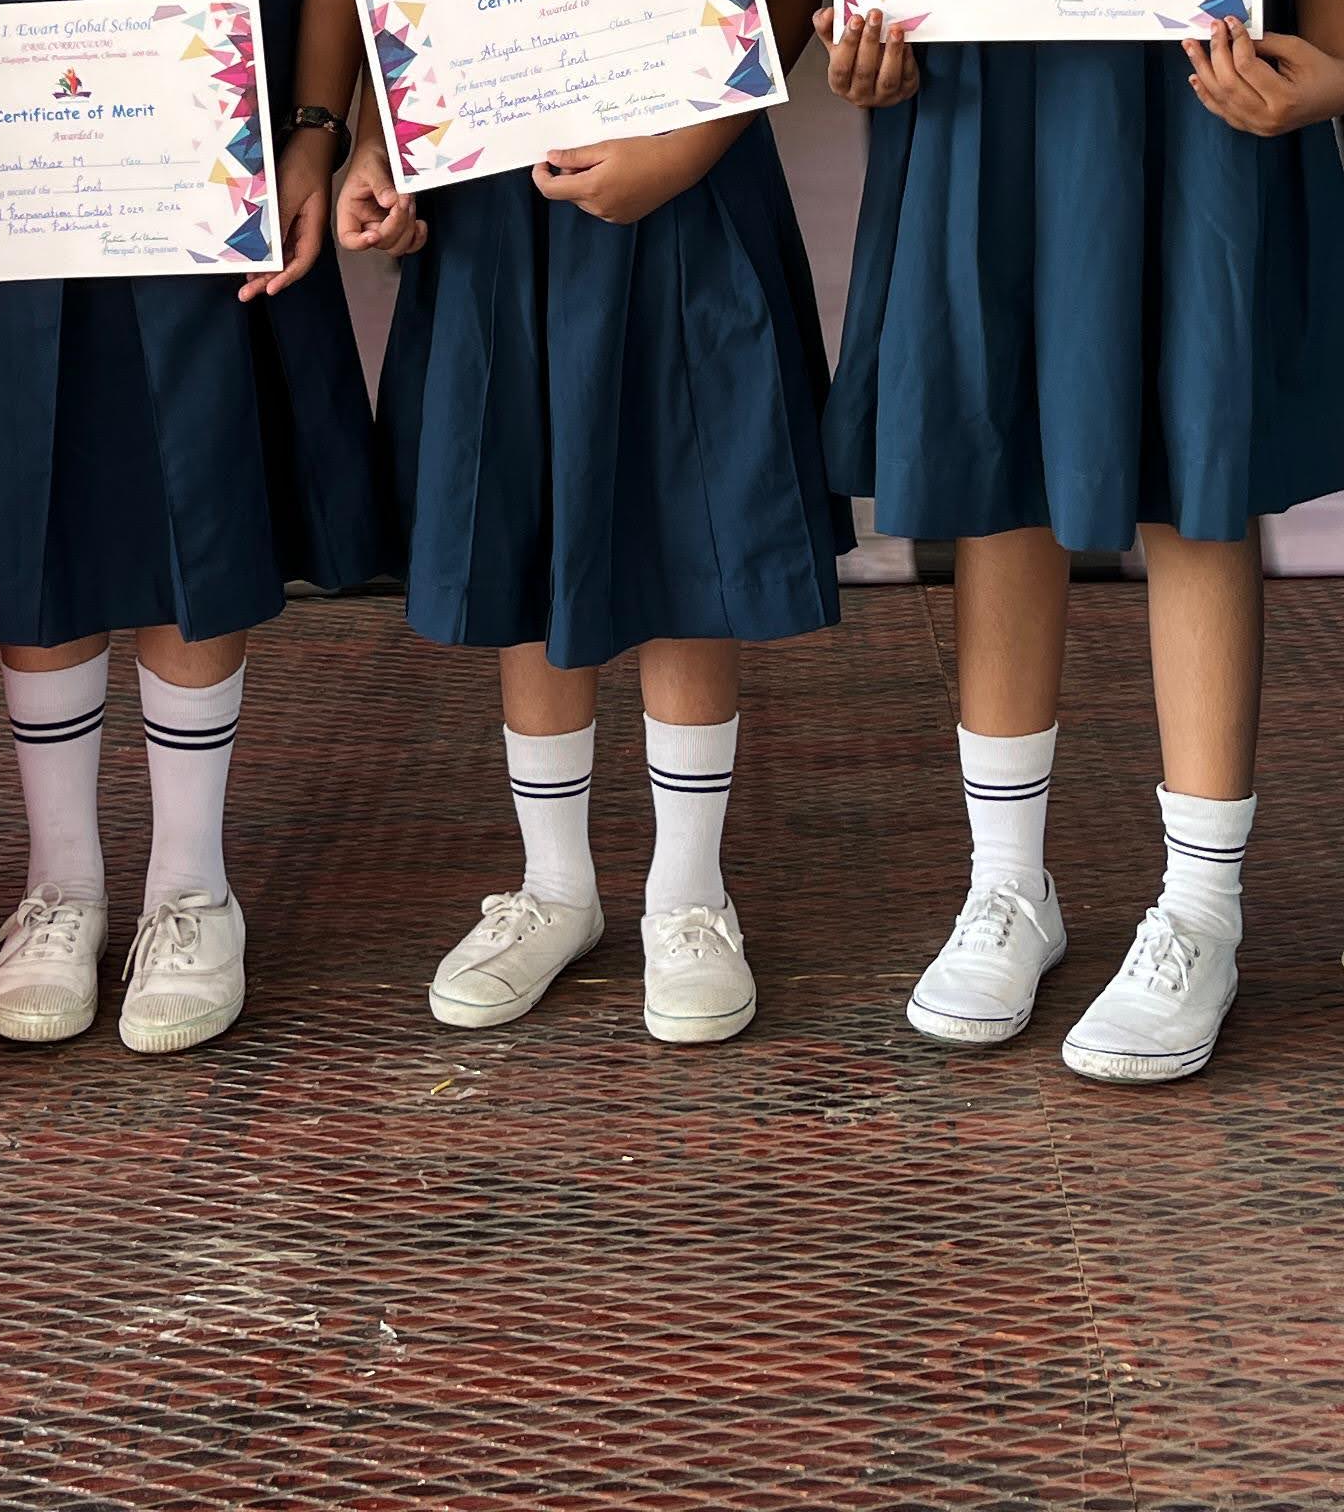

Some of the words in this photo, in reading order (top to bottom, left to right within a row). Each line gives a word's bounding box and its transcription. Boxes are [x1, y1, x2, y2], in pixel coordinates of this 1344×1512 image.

[536, 1, 577, 19] Awarded
[16, 23, 59, 37] Ewart
[64, 18, 106, 38] Global
[109, 15, 154, 33] School
[531, 29, 580, 51] Mariam
[496, 87, 557, 109] Preparation
[565, 75, 598, 93] Contest
[87, 105, 104, 119] of
[112, 103, 155, 119] Merit
[52, 130, 93, 143] Awarded
[72, 155, 86, 168] M
[7, 202, 72, 223] Preparation
[78, 204, 113, 219] Contest
